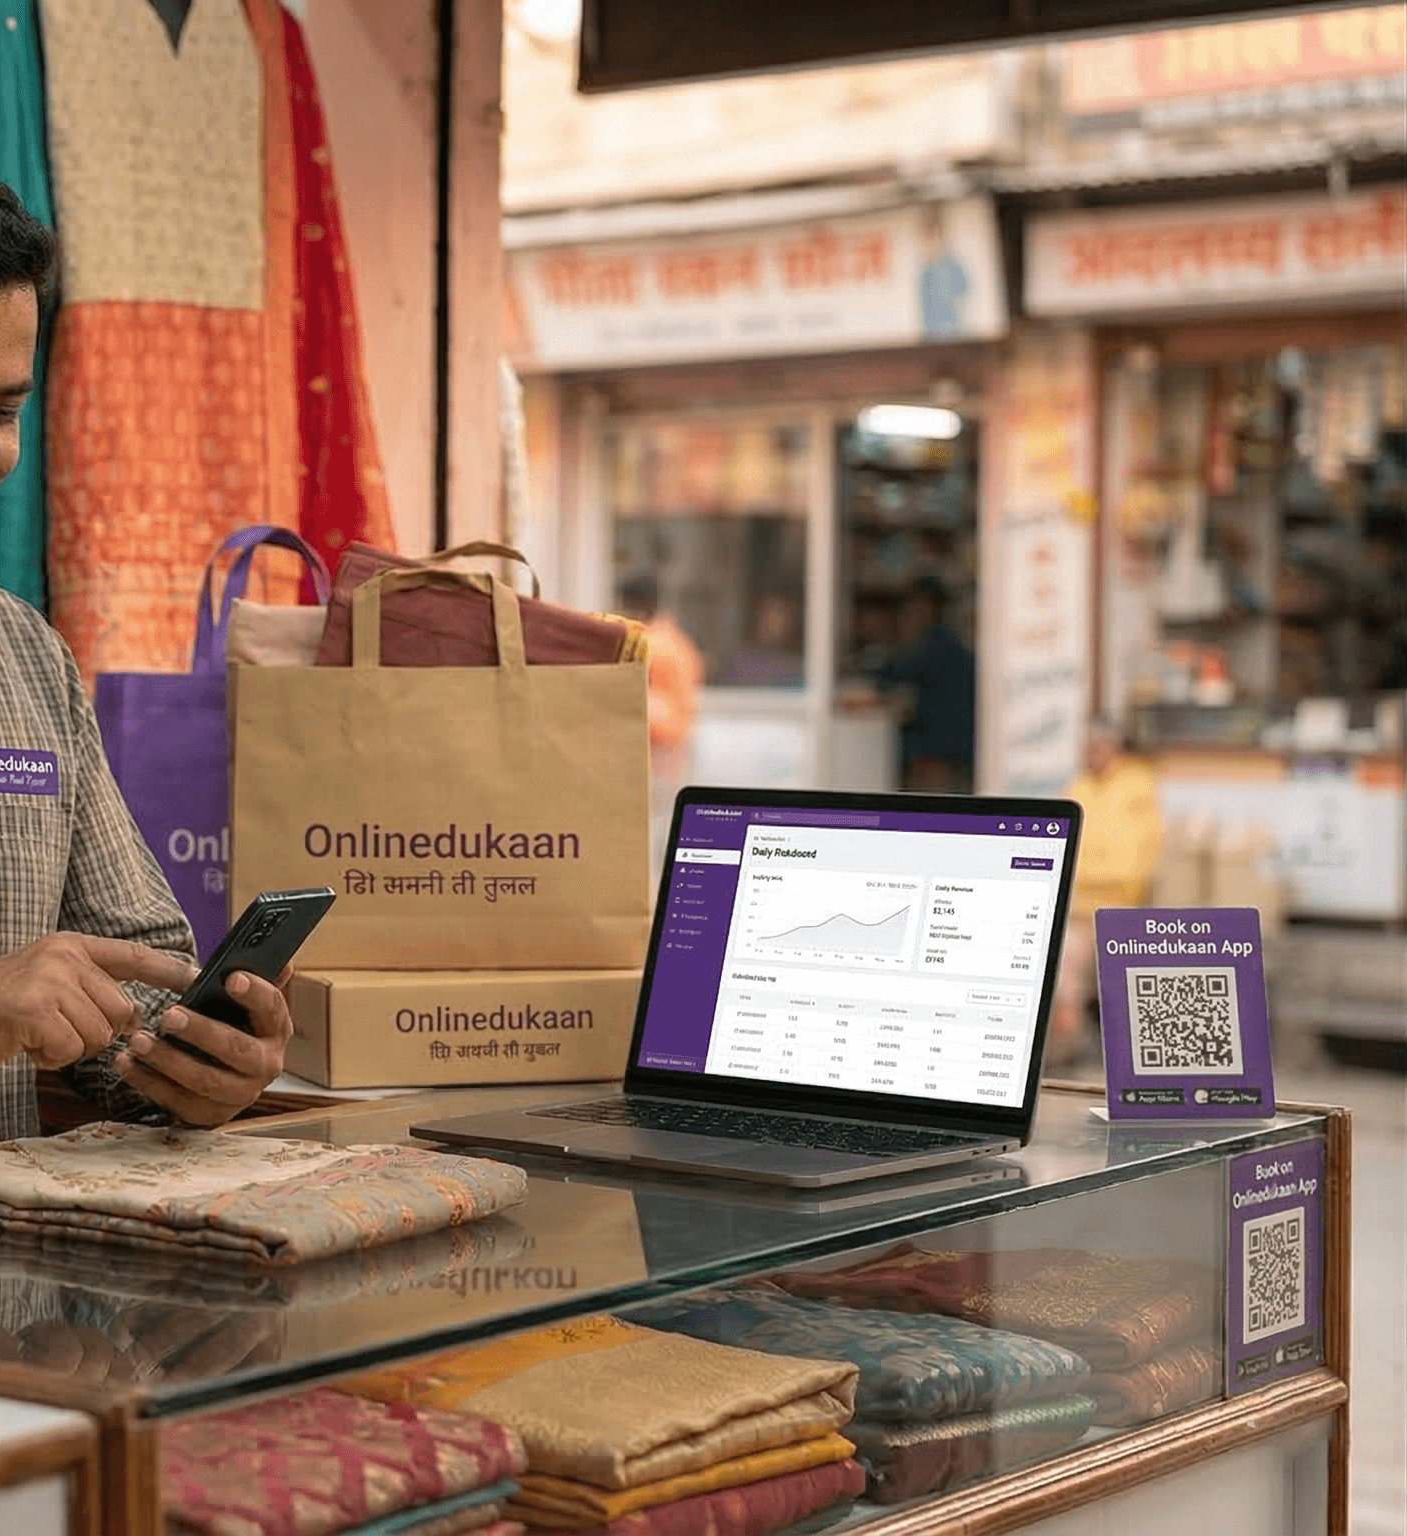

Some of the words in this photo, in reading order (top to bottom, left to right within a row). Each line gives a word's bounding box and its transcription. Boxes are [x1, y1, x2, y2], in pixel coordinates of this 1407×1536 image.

[304, 824, 580, 859] Onlinedukaan
[1145, 919, 1187, 934] Book
[1191, 922, 1211, 934] on
[1106, 939, 1217, 954] Onlinedukaan
[1221, 940, 1253, 957] App
[396, 1004, 593, 1033] Onlinedukaan
